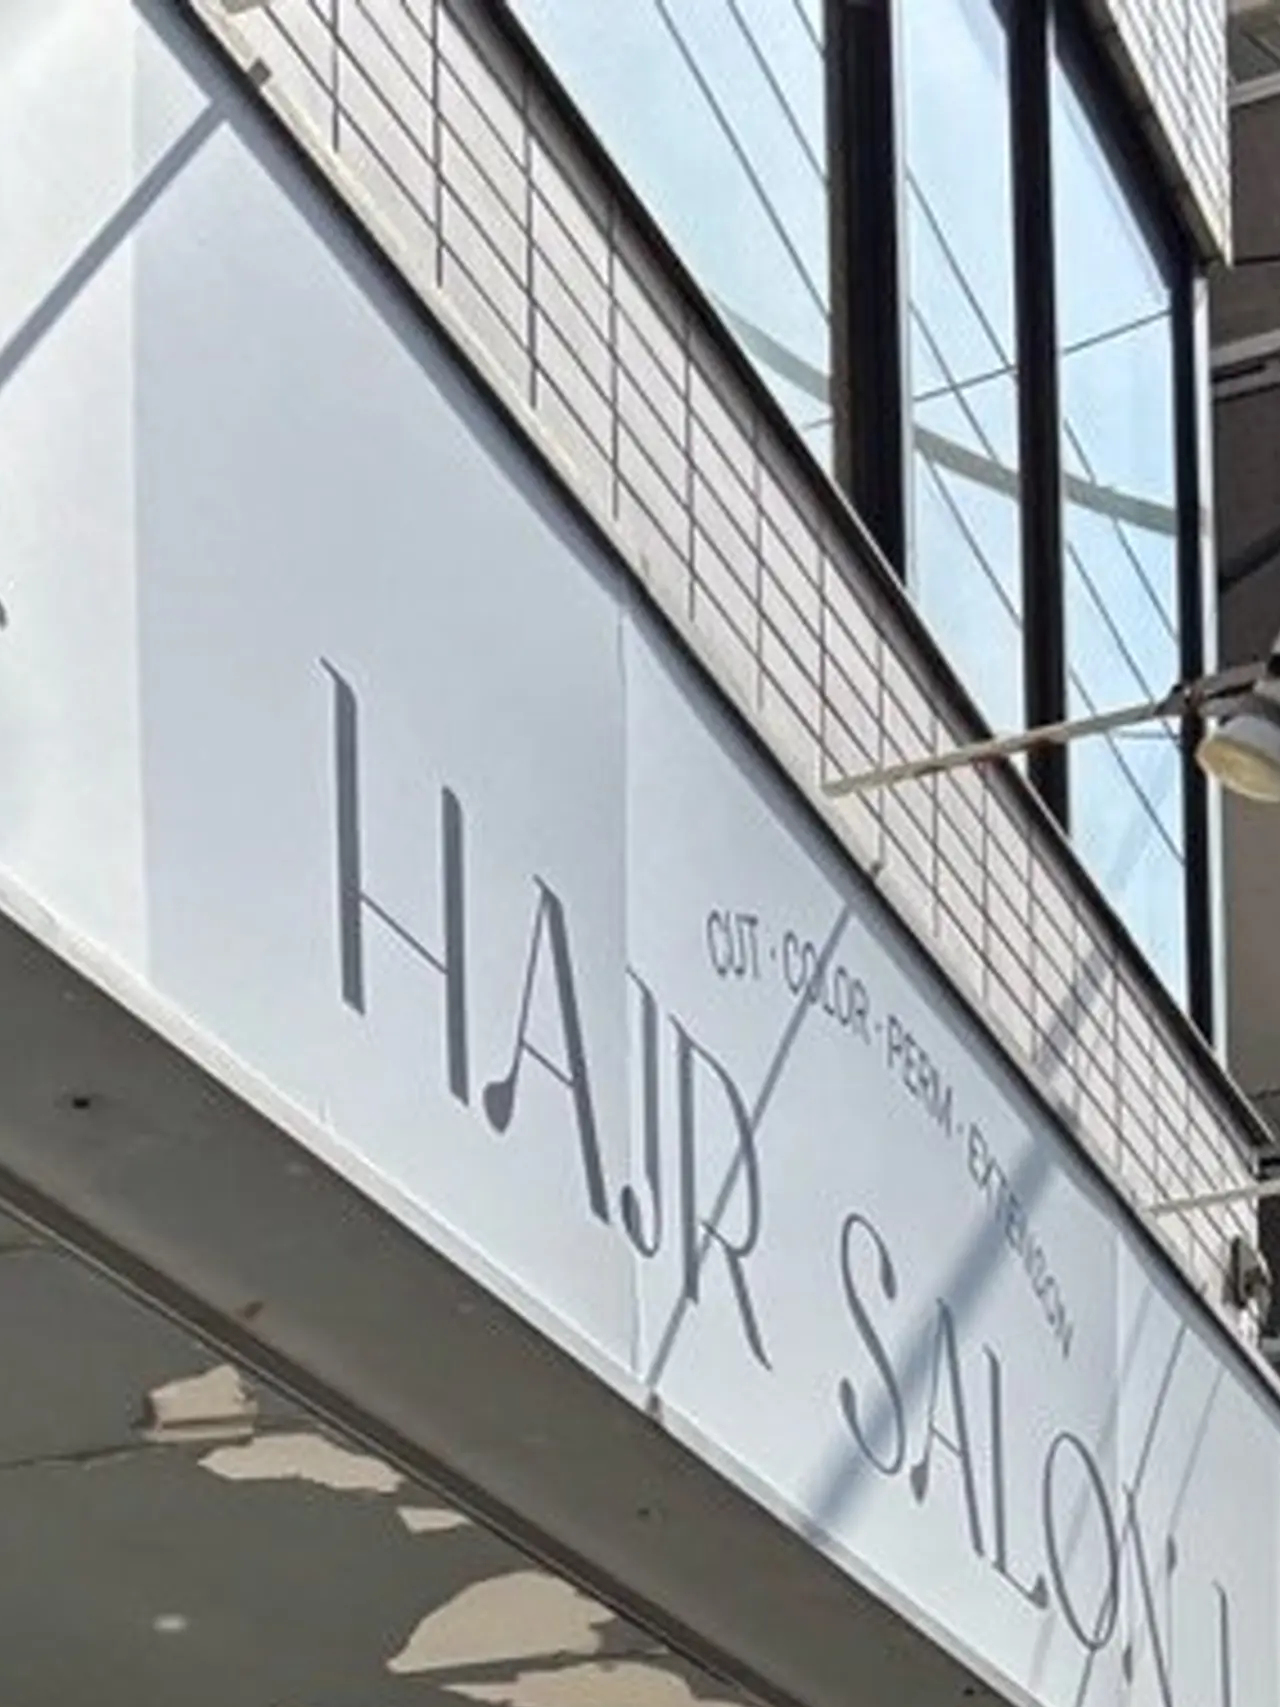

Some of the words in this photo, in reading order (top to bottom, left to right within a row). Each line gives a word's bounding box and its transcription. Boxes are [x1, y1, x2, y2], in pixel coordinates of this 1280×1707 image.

[706, 909, 761, 980] CUT
[782, 930, 871, 1046] COLOR
[885, 1013, 953, 1139] PERM
